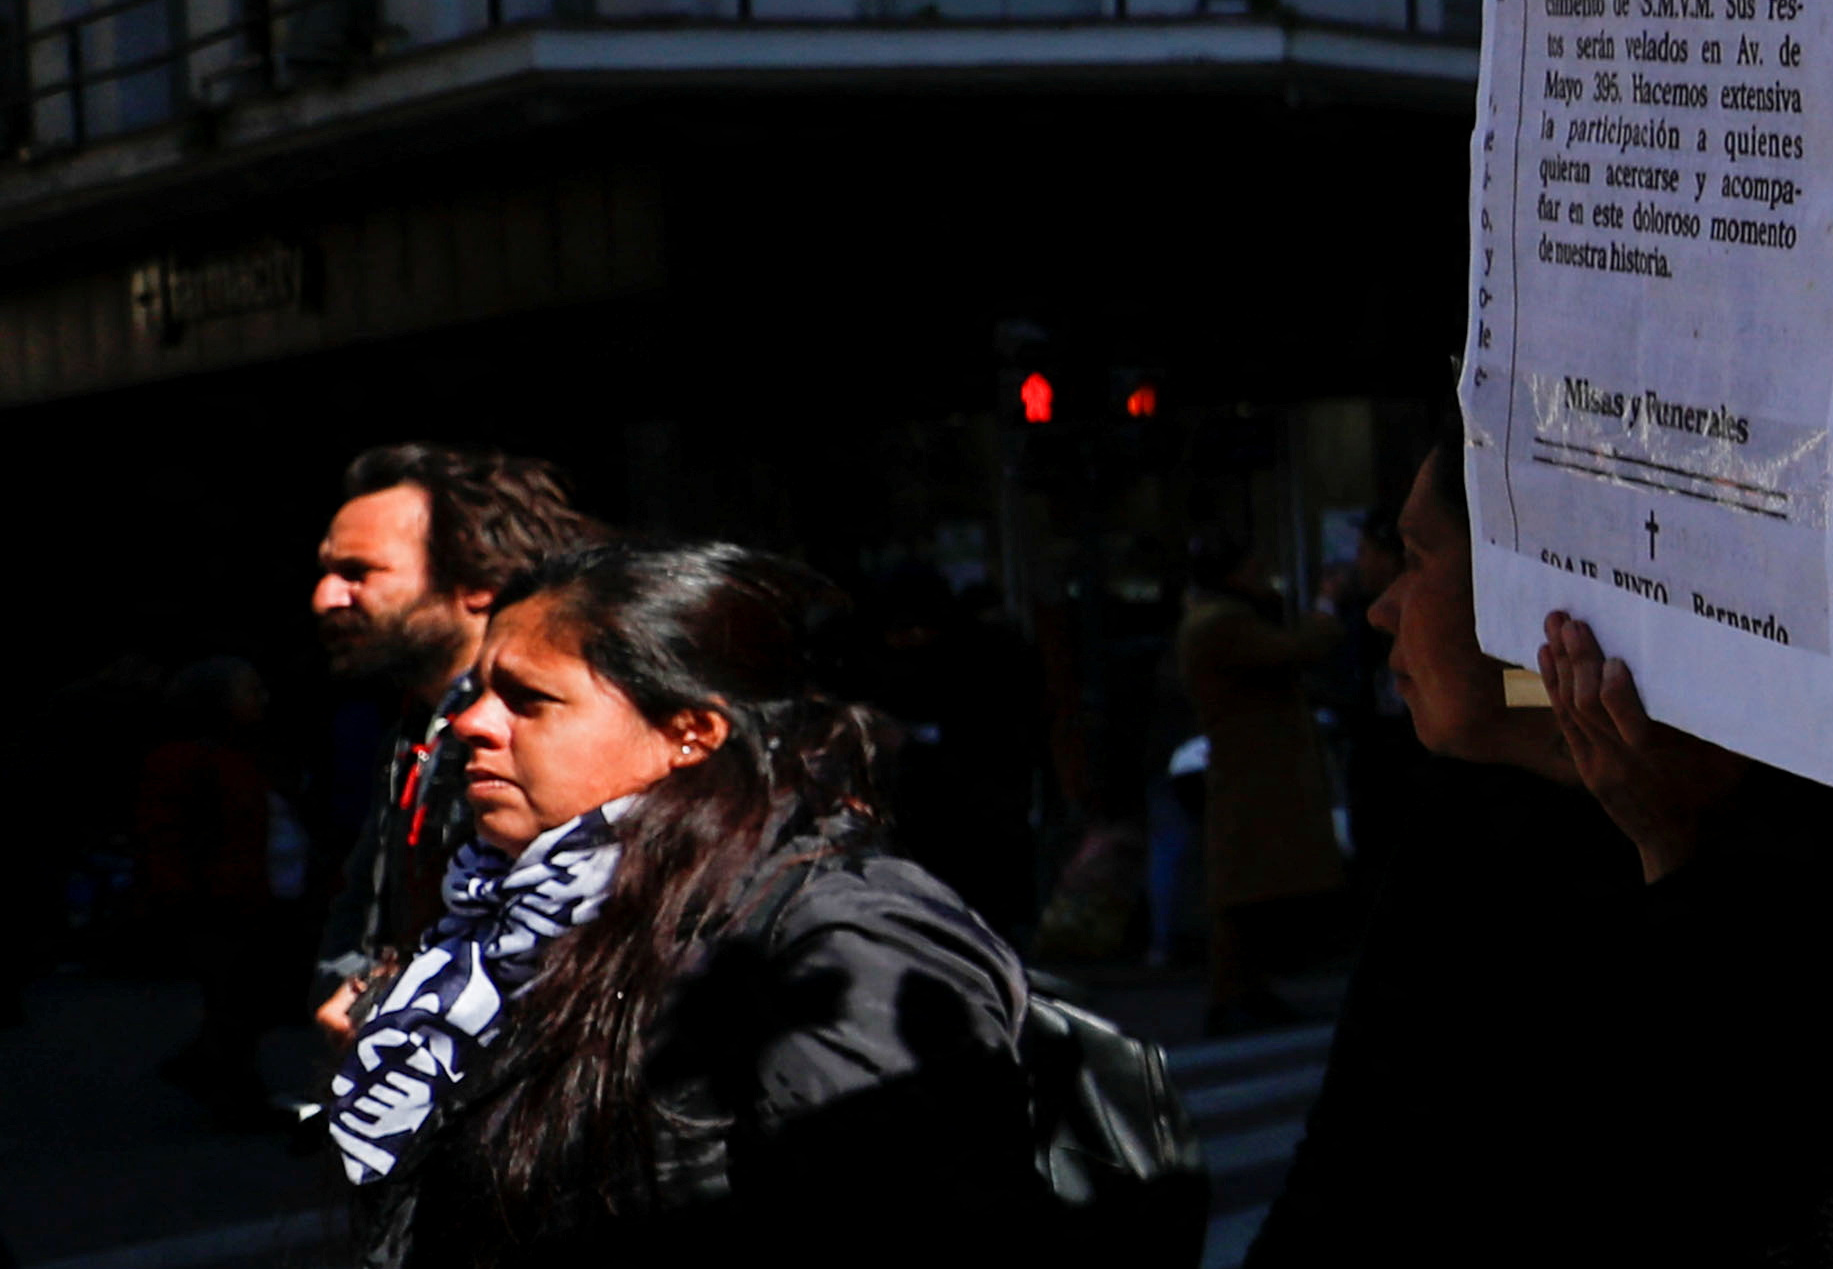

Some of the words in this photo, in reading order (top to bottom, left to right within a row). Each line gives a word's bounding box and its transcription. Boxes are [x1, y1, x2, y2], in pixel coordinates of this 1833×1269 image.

[1548, 33, 1564, 58] tos
[1576, 29, 1614, 60] serán
[1625, 29, 1688, 64] velados
[1701, 40, 1722, 65] en
[1737, 33, 1763, 66] Av.
[1779, 34, 1801, 68] de
[1544, 69, 1583, 108] Mayo
[1593, 71, 1622, 104] 395.
[1632, 72, 1708, 109] Hacemos
[1721, 80, 1802, 114] extensiva
[1541, 110, 1554, 140] la
[1565, 114, 1681, 151] participación
[1697, 128, 1707, 153] a
[1724, 124, 1803, 163] quienes
[1539, 153, 1590, 188] quieran
[1606, 163, 1679, 193] acercarse
[1694, 172, 1706, 203] y
[1721, 173, 1802, 211] acompa-
[1537, 192, 1561, 222] ñar
[1568, 202, 1583, 225] en
[1593, 202, 1623, 229] este
[1633, 200, 1700, 239] doloroso
[1710, 217, 1796, 250] momento
[1539, 232, 1553, 263] de
[1554, 240, 1607, 270] nuestra
[1610, 240, 1672, 279] historia.
[1563, 373, 1625, 419] Misas
[1628, 394, 1643, 430] y
[1644, 389, 1751, 446] Funerales
